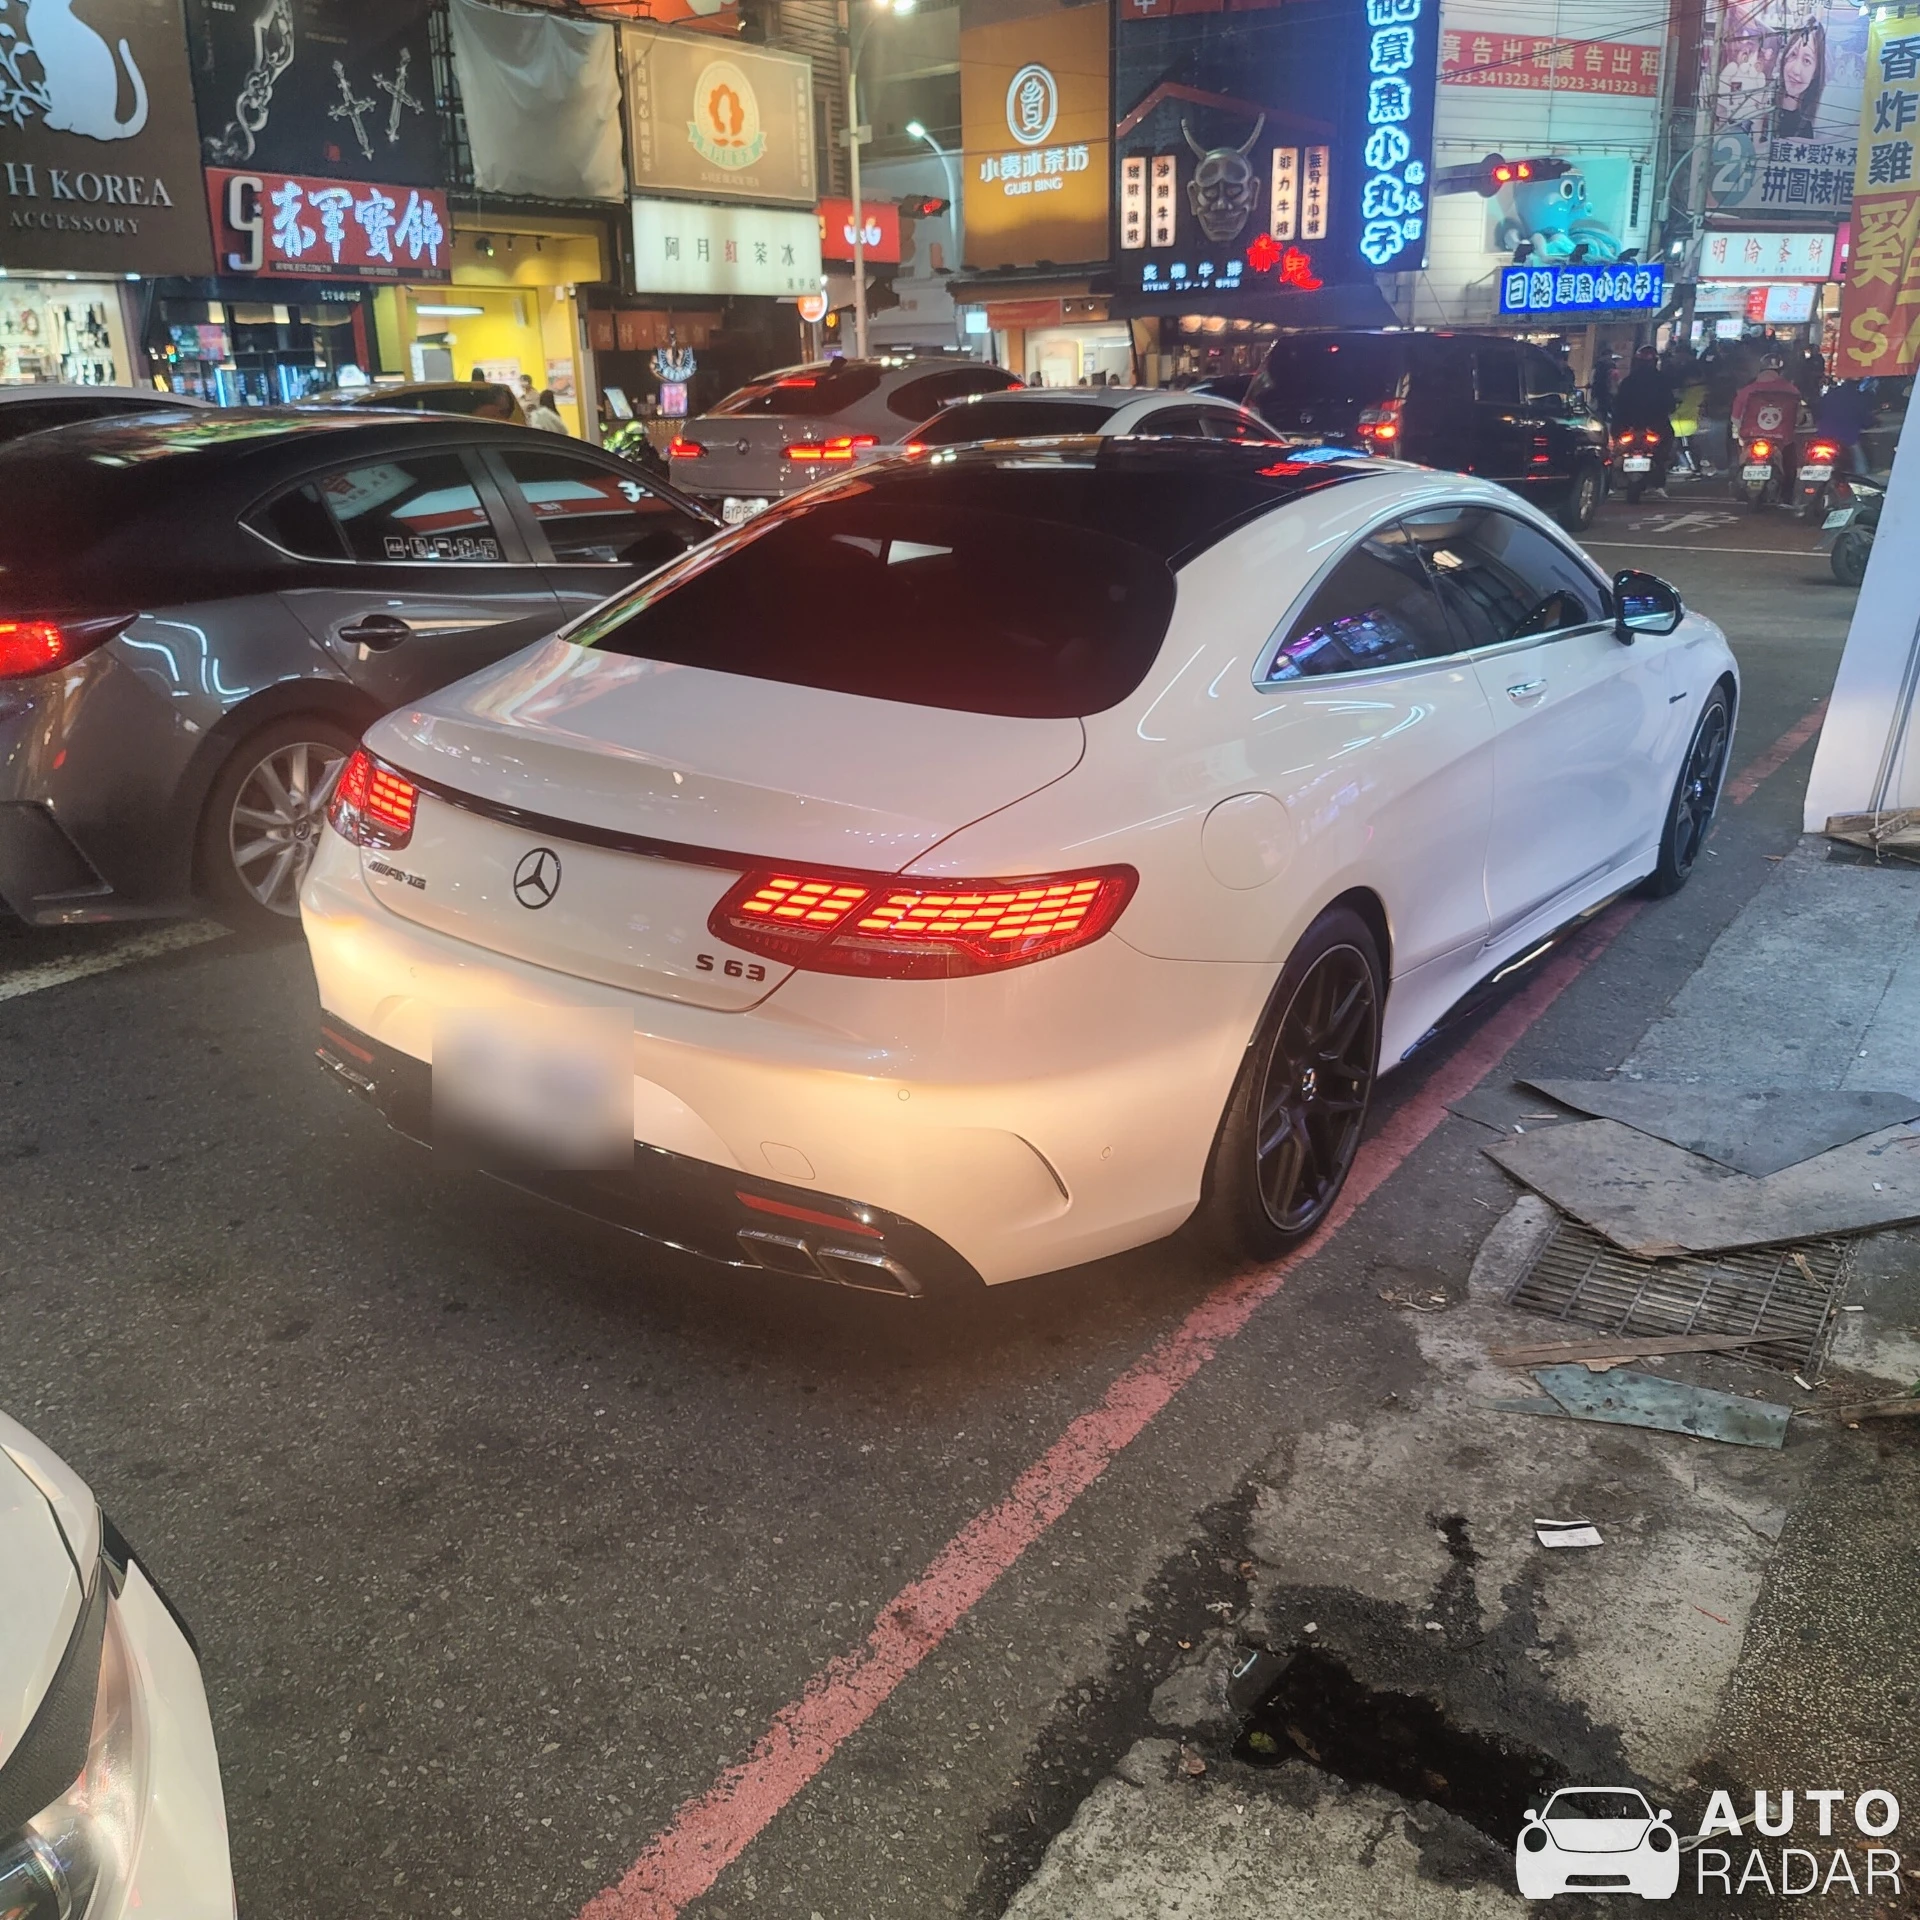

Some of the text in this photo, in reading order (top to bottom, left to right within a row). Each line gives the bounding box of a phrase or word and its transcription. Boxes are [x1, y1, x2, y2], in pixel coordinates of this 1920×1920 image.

[1553, 74, 1638, 94] 0923-341323
[1868, 39, 1920, 185] 香炸雞
[979, 143, 1089, 183] 小貴冰茶坊
[48, 168, 174, 208] KOREA
[1004, 177, 1064, 196] GUEI BING
[9, 209, 140, 235] ACCESSORY
[664, 235, 795, 267] 阿月紅茶冰
[1247, 232, 1324, 290] 赤鬼
[1712, 236, 1824, 264] 明倫蛋餅
[1143, 259, 1243, 281] 炙燒牛排
[1142, 281, 1170, 292] STEAK
[383, 866, 427, 891] AMG
[695, 954, 766, 982] S 63
